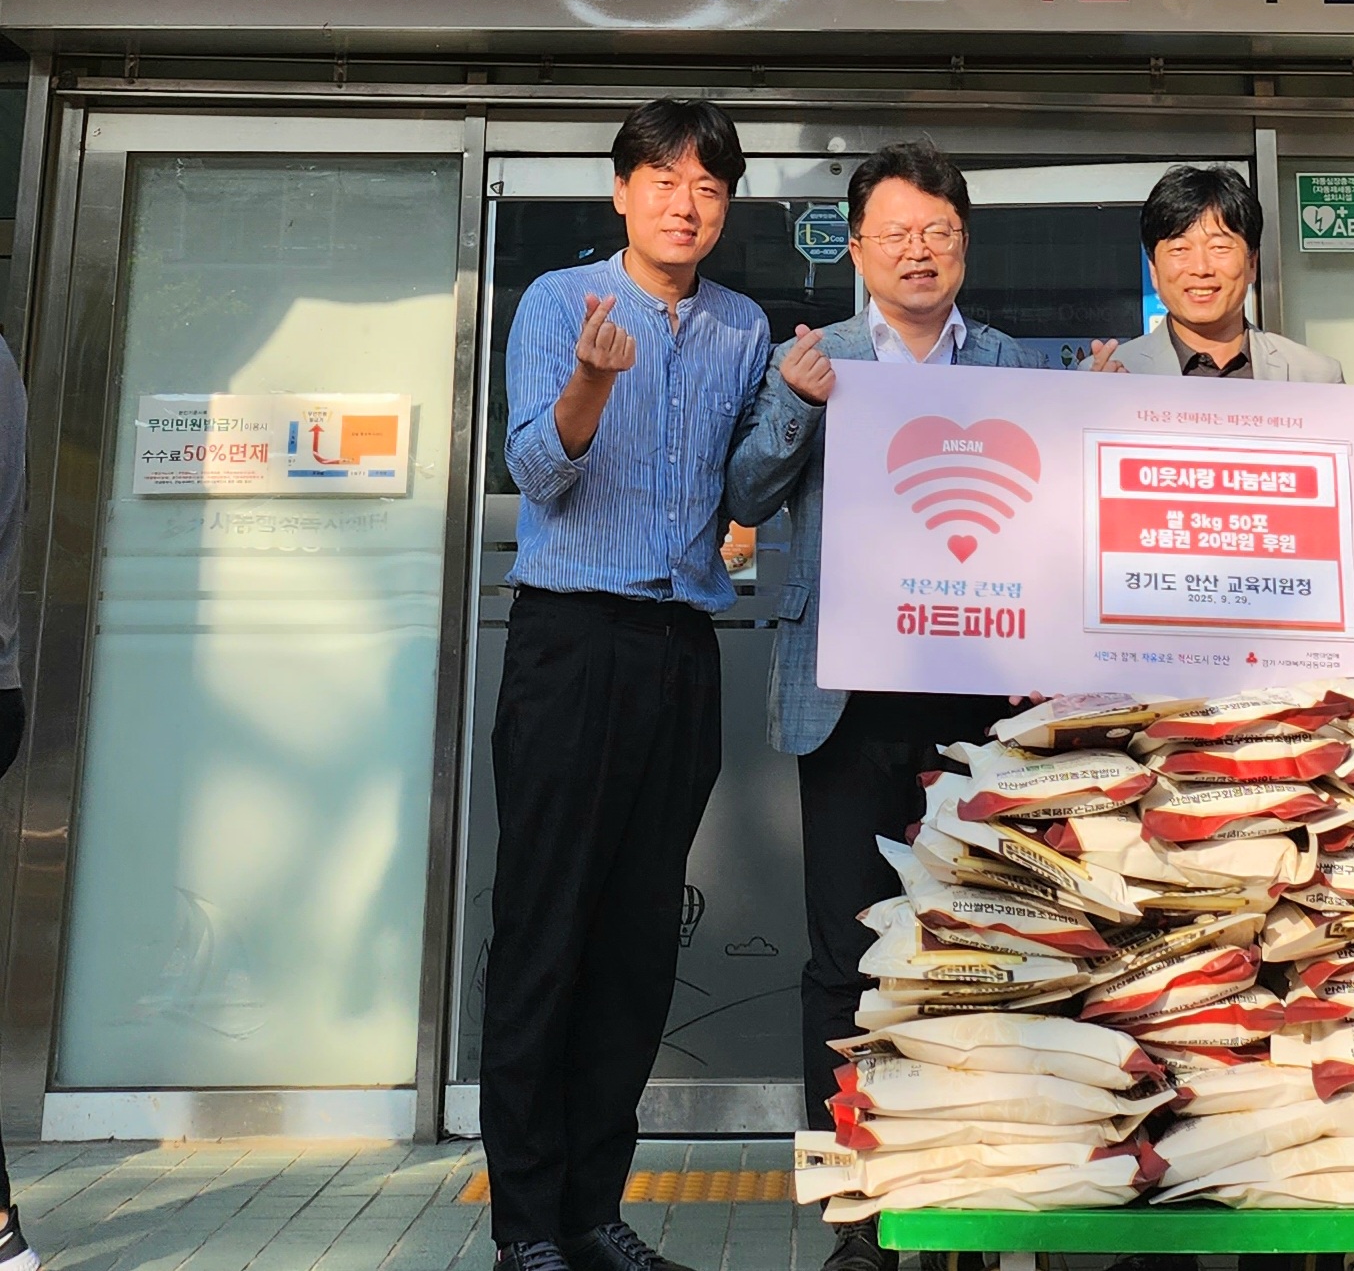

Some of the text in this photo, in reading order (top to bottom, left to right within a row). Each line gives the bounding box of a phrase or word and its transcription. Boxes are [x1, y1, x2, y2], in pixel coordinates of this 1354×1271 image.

[1267, 417, 1304, 429] 에너지
[942, 439, 983, 453] ANSAN
[1139, 466, 1216, 489] 이웃사랑
[1166, 510, 1268, 533] 쌀 3kg 50포
[1139, 529, 1296, 553] 상품권 20만원 후원
[901, 578, 967, 596] 작은사랑
[1125, 572, 1177, 592] 경기도
[1184, 574, 1219, 593] 안산
[1187, 594, 1251, 605] 2025. 9. 29.
[897, 602, 1026, 639] 하트파이
[1094, 651, 1117, 662] 시민과
[1213, 655, 1231, 666] 안산
